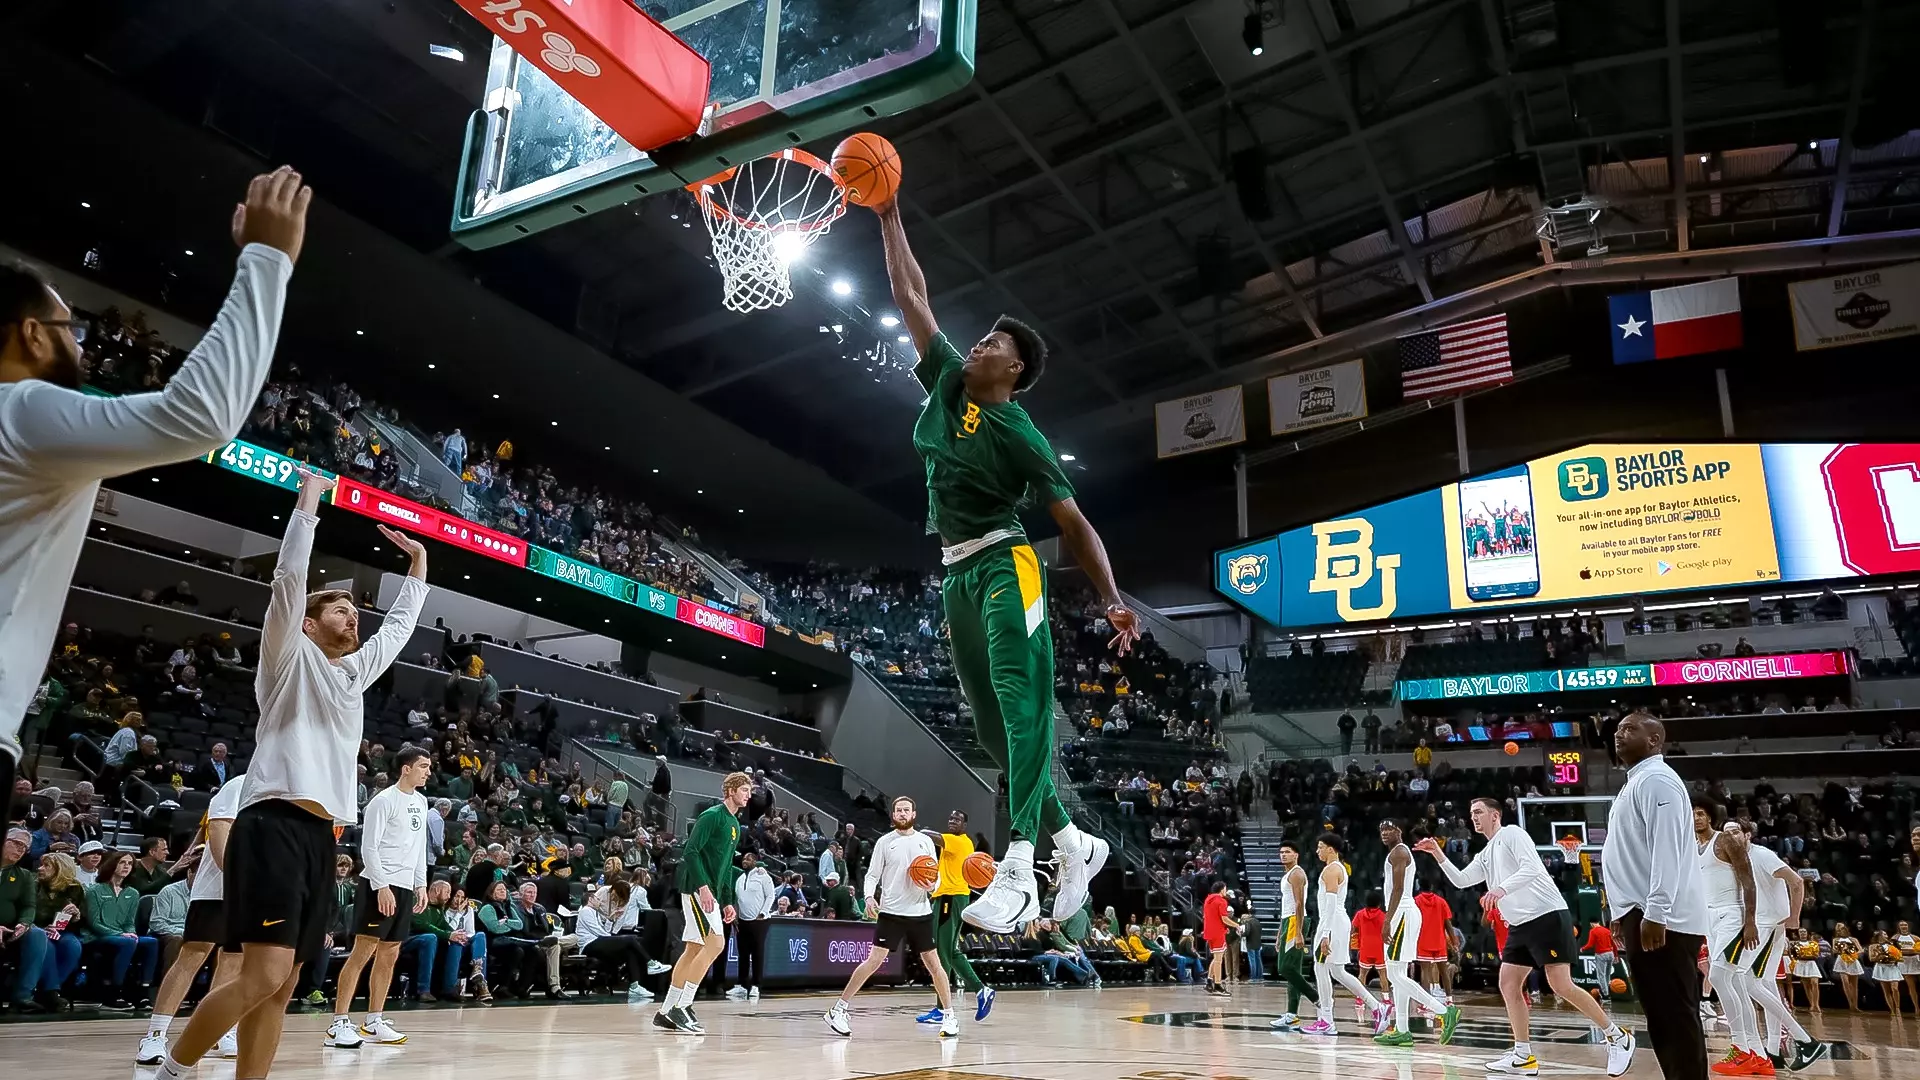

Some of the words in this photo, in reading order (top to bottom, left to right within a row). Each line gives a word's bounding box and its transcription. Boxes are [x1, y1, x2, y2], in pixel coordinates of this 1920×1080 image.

[1834, 273, 1881, 290] BAYLOR
[1837, 308, 1861, 317] FINAL
[1864, 303, 1889, 313] FOUR
[1299, 370, 1331, 384] BAYLOR
[1184, 395, 1213, 409] BAYLOR
[220, 442, 293, 483] 45:59
[1615, 449, 1684, 474] BAYLOR
[1566, 463, 1600, 496] BU
[1617, 468, 1688, 491] SPORTS
[1692, 461, 1730, 482] APP
[351, 489, 360, 504] 0
[379, 501, 421, 524] CORNELL
[1557, 513, 1576, 523] Your
[1578, 508, 1622, 520] all-in-one
[1625, 506, 1641, 516] app
[1643, 502, 1656, 512] for
[1659, 500, 1690, 512] Baylor
[1693, 494, 1741, 507] Athletics,
[1579, 522, 1598, 531] now
[1600, 515, 1643, 529] including
[1645, 513, 1680, 526] BAYLOR
[1697, 508, 1721, 520] BOLD
[461, 528, 468, 540] 0
[1581, 537, 1617, 551] Available
[1618, 538, 1627, 547] to
[1628, 536, 1639, 545] all
[1640, 533, 1667, 545] Baylor
[1668, 532, 1688, 542] Fans
[1689, 530, 1701, 540] for
[1703, 528, 1722, 537] FREE
[1603, 549, 1611, 558] in
[1612, 548, 1630, 559] your
[1631, 544, 1658, 556] mobile
[1660, 544, 1675, 554] app
[1677, 541, 1701, 551] store.
[1309, 517, 1401, 622] BU
[1594, 569, 1615, 579] App
[1616, 565, 1643, 576] Store
[1677, 560, 1709, 571] Google
[1712, 557, 1733, 567] play
[556, 558, 614, 597] BAYLOR
[649, 590, 666, 611] VS
[695, 608, 747, 640] CORNELL
[1566, 670, 1617, 688] 45:59
[1625, 669, 1642, 677] 1ST
[1681, 658, 1802, 683] CORNELL
[1443, 674, 1529, 697] BAYLOR
[1622, 677, 1647, 686] HALF
[1549, 752, 1580, 764] 45:59
[1554, 764, 1579, 784] 30
[789, 938, 808, 962] VS
